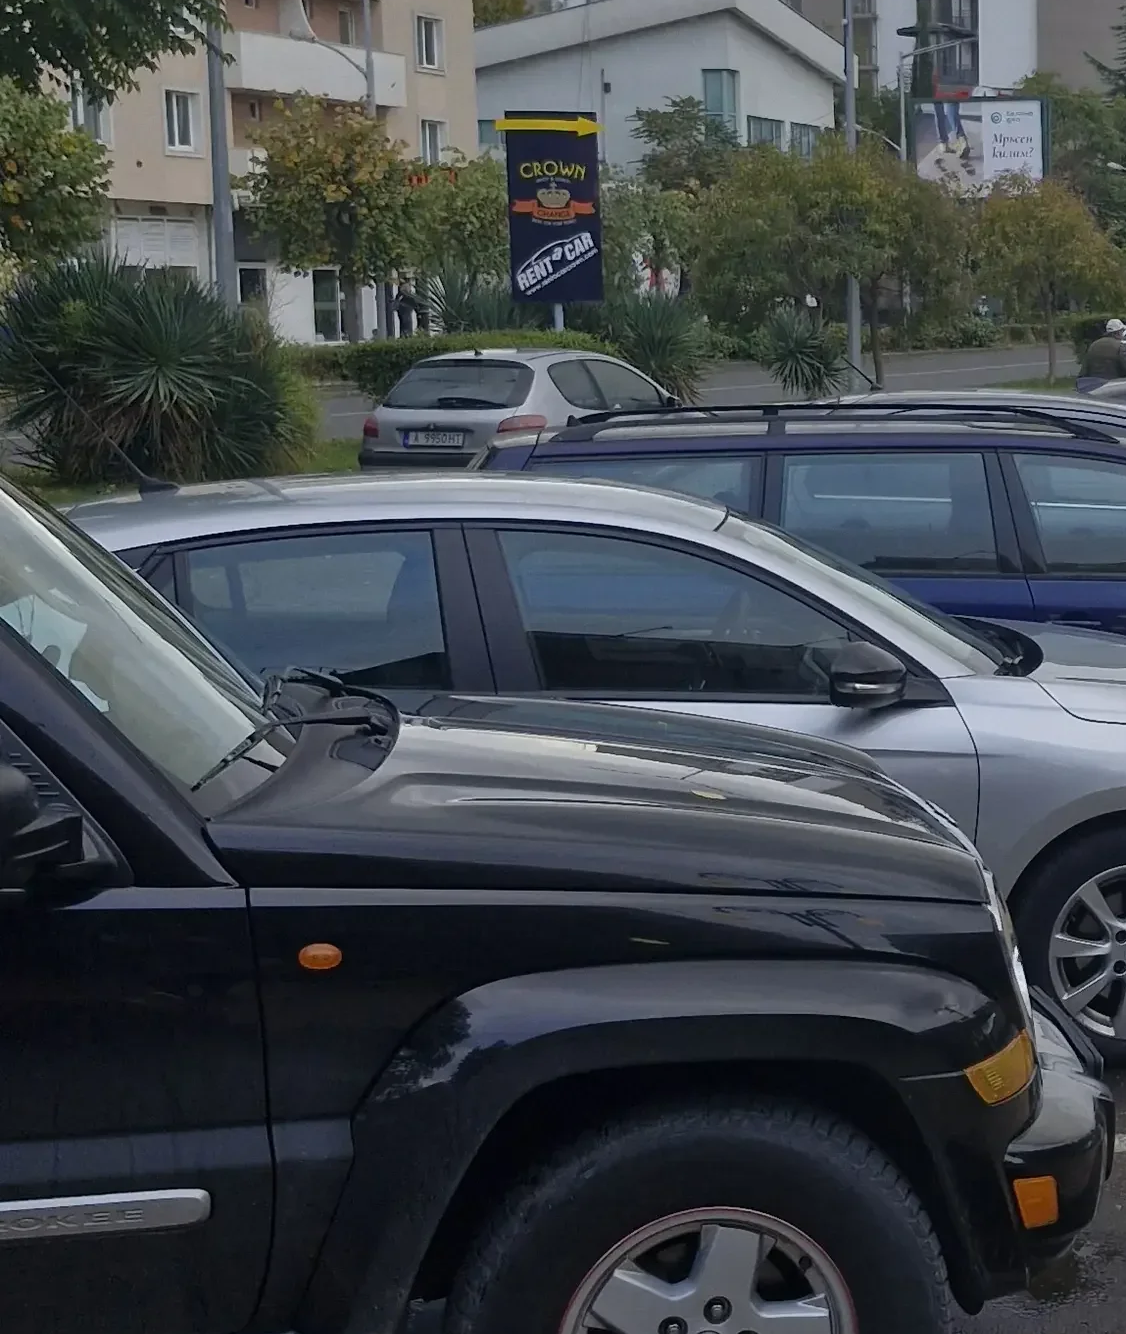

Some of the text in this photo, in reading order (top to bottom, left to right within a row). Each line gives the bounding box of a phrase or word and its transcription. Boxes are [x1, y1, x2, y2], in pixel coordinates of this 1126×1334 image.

[992, 133, 1033, 147] Мръсен
[520, 160, 586, 180] CROWN
[517, 257, 553, 291] RENT
[564, 233, 594, 261] CAR
